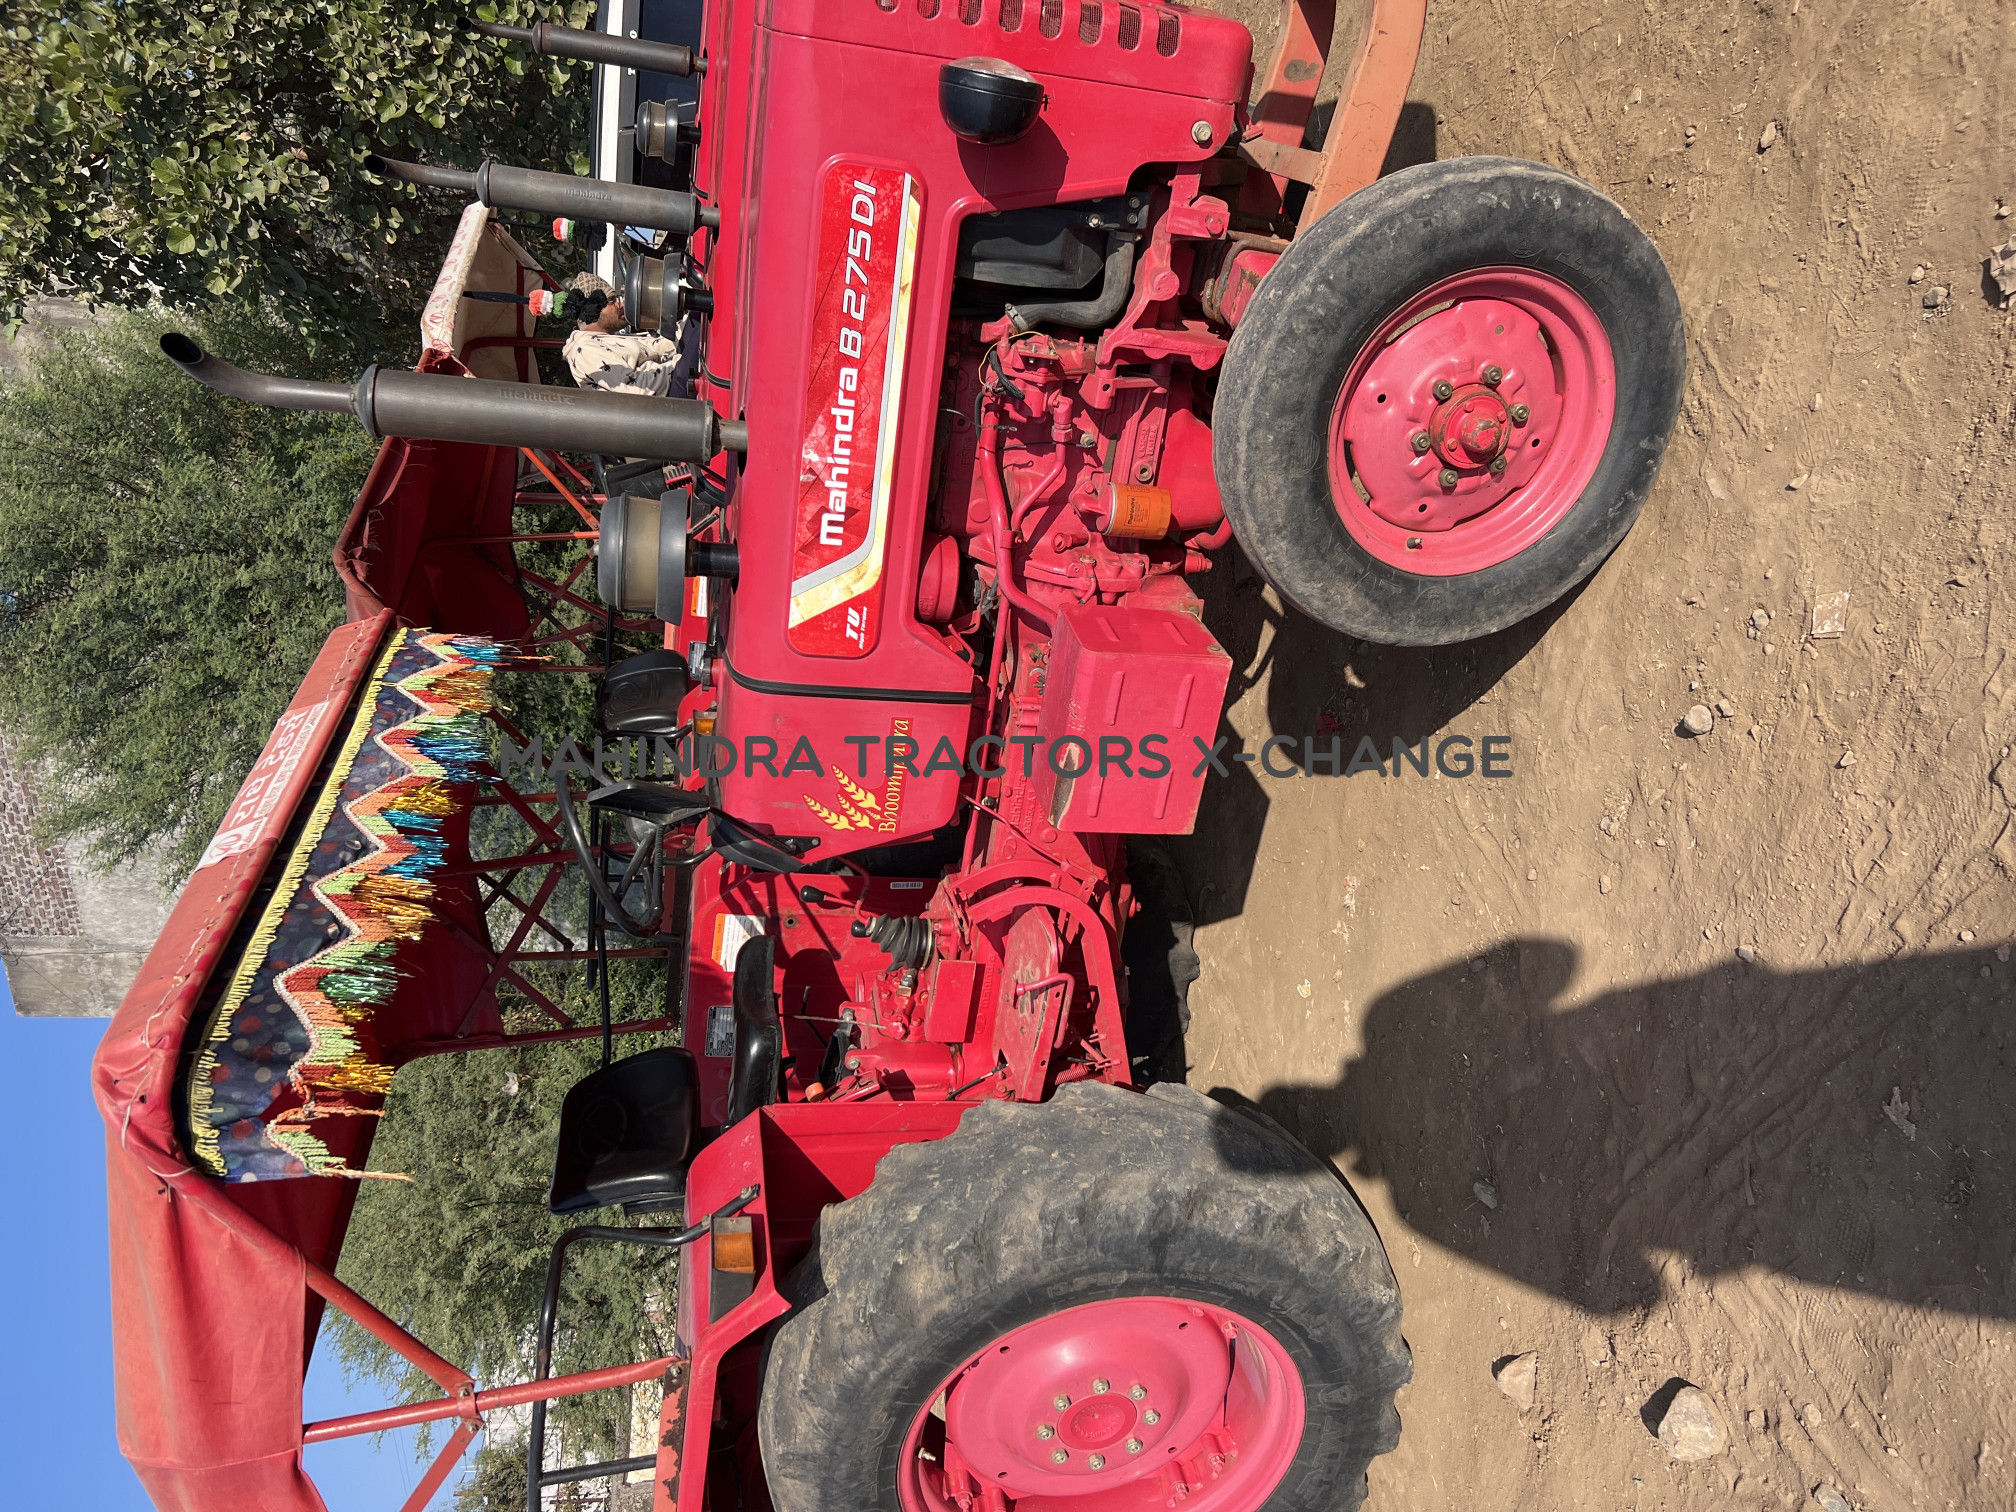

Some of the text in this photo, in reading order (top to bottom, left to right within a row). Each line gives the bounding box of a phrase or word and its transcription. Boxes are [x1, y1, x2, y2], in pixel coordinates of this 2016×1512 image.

[819, 367, 858, 546] Mahindra
[839, 327, 863, 360] B
[845, 606, 860, 641] TU
[877, 719, 911, 833] Bhoomipura
